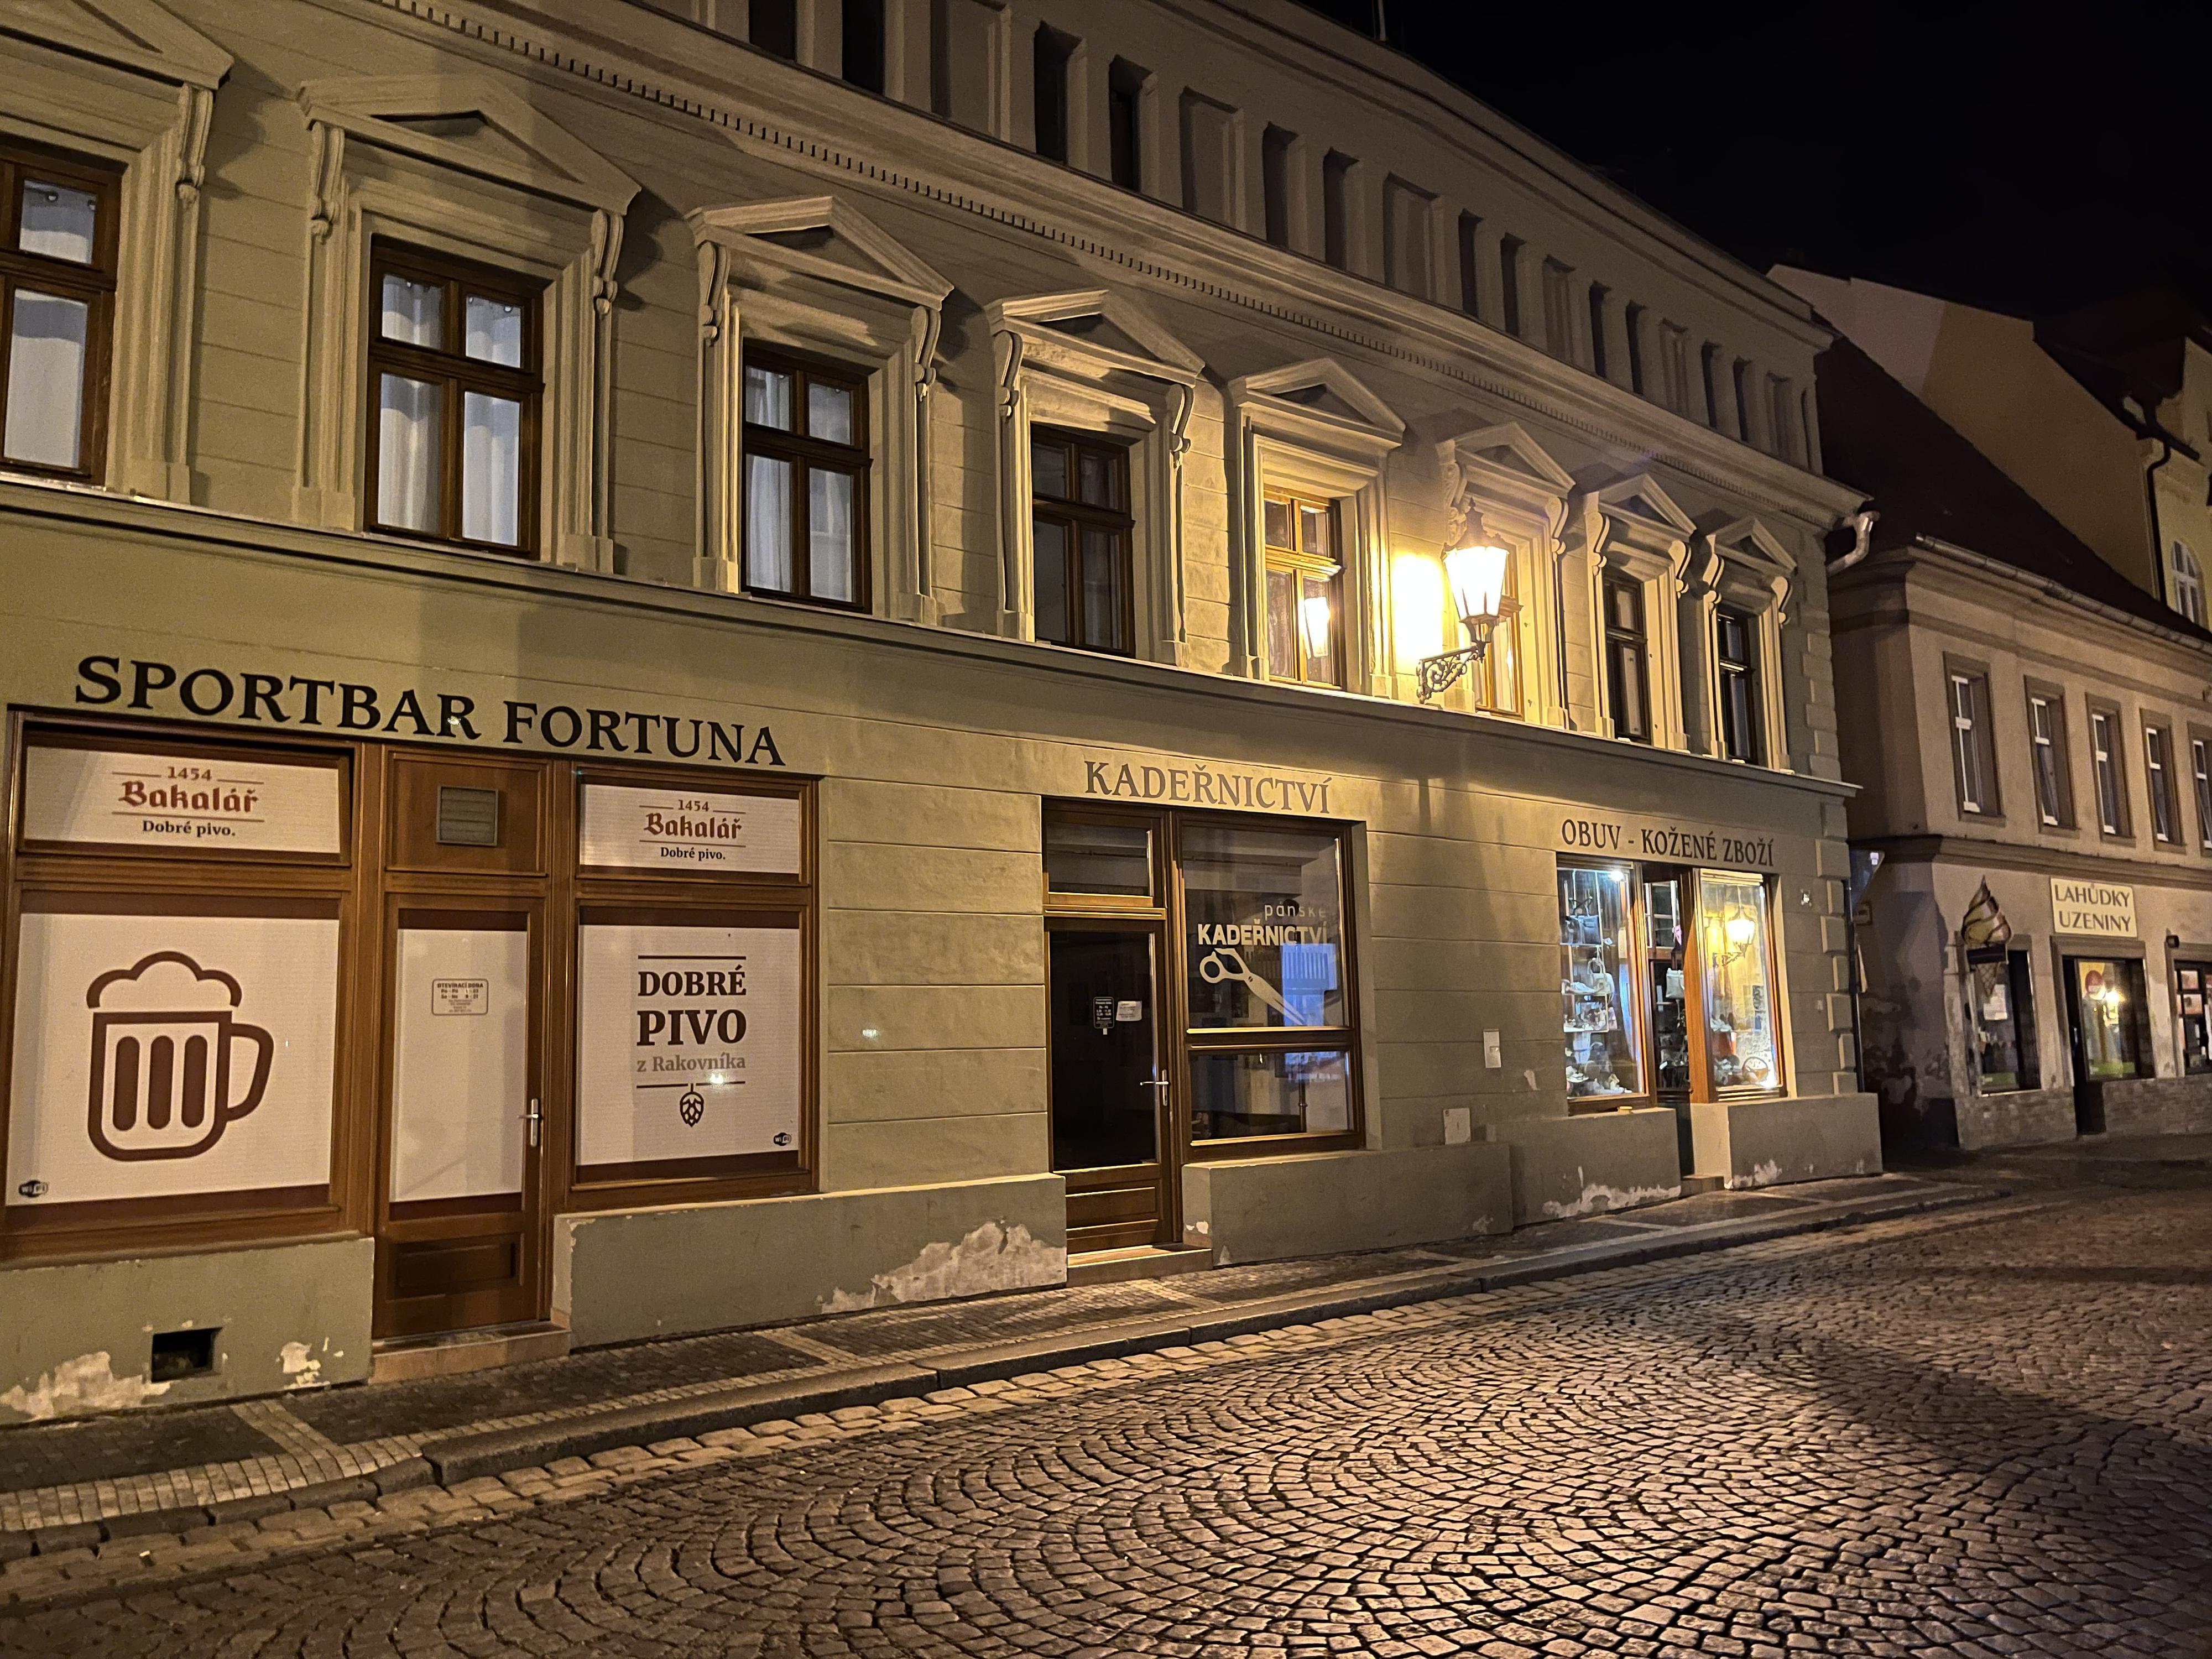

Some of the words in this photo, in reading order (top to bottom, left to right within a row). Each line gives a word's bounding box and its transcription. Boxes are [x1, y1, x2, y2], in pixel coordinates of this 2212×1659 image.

[75, 656, 481, 740] SPORTBAR
[503, 700, 786, 766] FORTUNA
[168, 766, 212, 781] 1454
[118, 780, 259, 812] Bakalář
[1084, 760, 1332, 815] KADEŘNICTVÍ
[678, 799, 709, 812] 1454
[142, 820, 191, 834] Dobré
[196, 822, 236, 837] pivo.
[644, 812, 742, 839] Bakalář
[660, 847, 695, 858] Dobré
[698, 848, 726, 861] pivo.
[1562, 819, 1621, 850] OBUV
[1641, 826, 1717, 860] KOŽENÉ
[1723, 837, 1775, 867] ZBOŽÍ
[1198, 919, 1327, 946] KADEŘNICTVÍ
[2059, 911, 2131, 932] UZENINY
[638, 964, 747, 996] DOBRÉ
[637, 1009, 747, 1046] PIVO
[637, 1060, 646, 1072] z
[652, 1052, 746, 1071] Rakovníka
